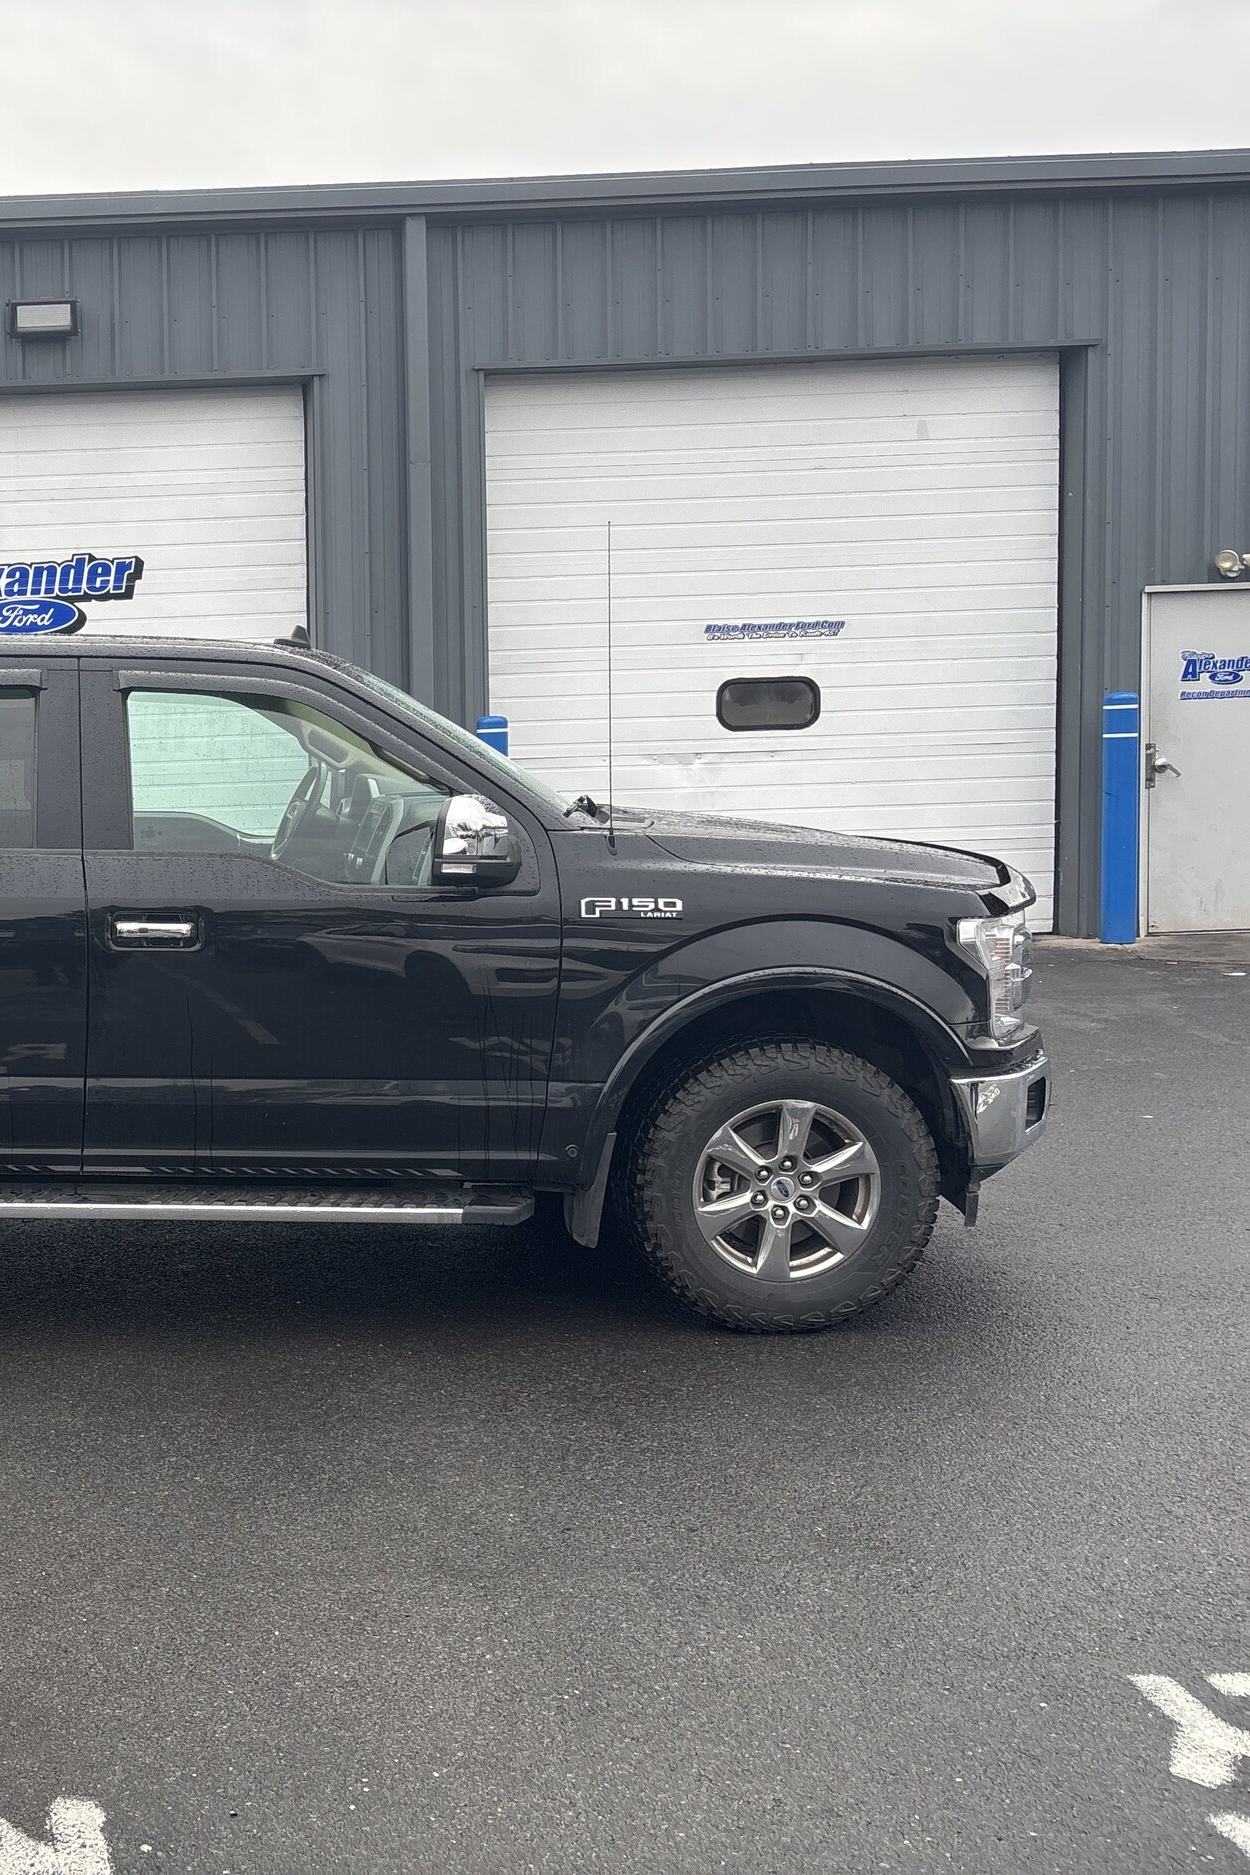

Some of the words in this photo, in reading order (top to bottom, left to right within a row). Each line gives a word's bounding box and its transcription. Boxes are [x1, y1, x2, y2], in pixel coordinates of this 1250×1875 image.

[704, 623, 740, 634] Blaise
[739, 622, 795, 632] Alexander
[1181, 656, 1250, 681] Alexande
[1214, 672, 1235, 681] Ford
